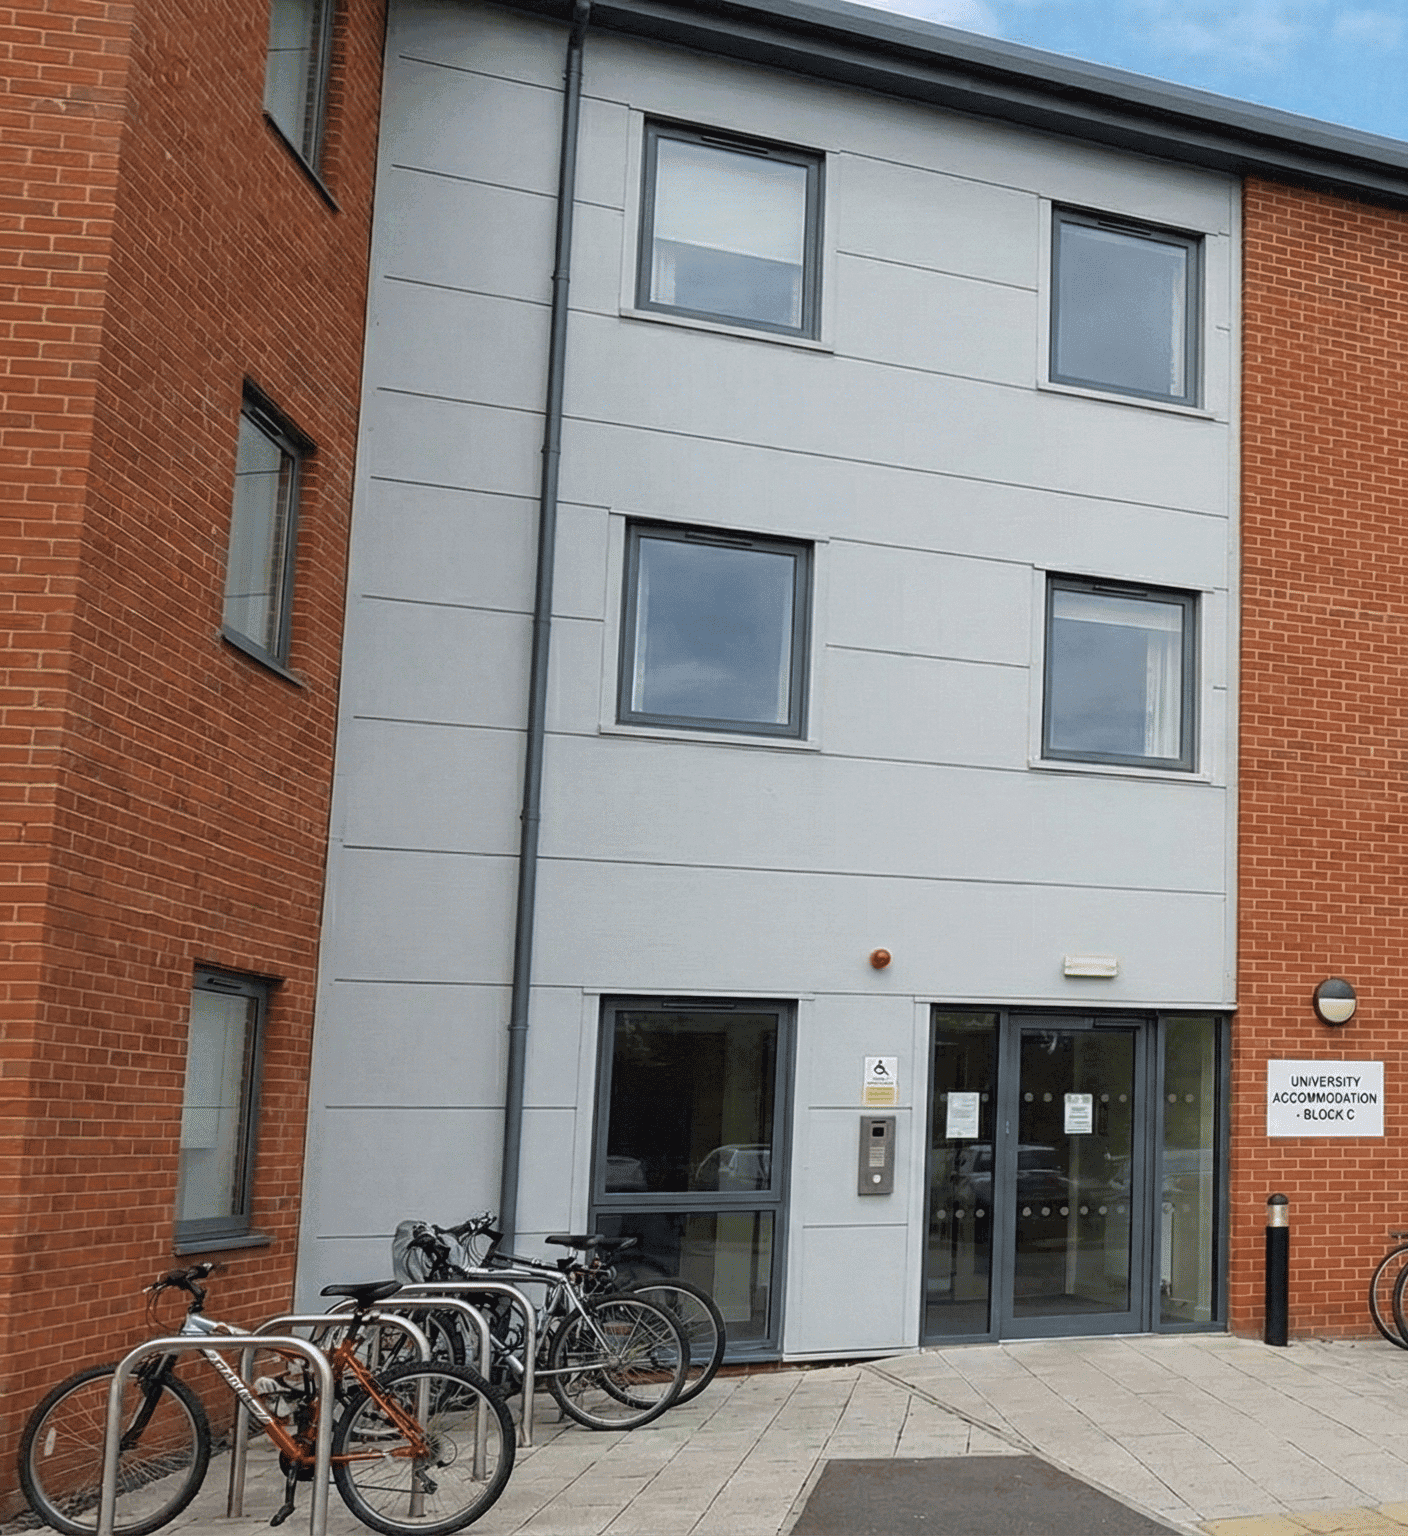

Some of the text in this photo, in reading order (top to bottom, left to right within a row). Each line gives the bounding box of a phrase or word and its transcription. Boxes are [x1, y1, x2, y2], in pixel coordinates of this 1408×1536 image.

[1291, 1076, 1361, 1088] UNIVERSITY
[1272, 1091, 1377, 1104] ACCOMMODATION
[1303, 1108, 1344, 1120] BLOCK
[1346, 1108, 1355, 1120] C
